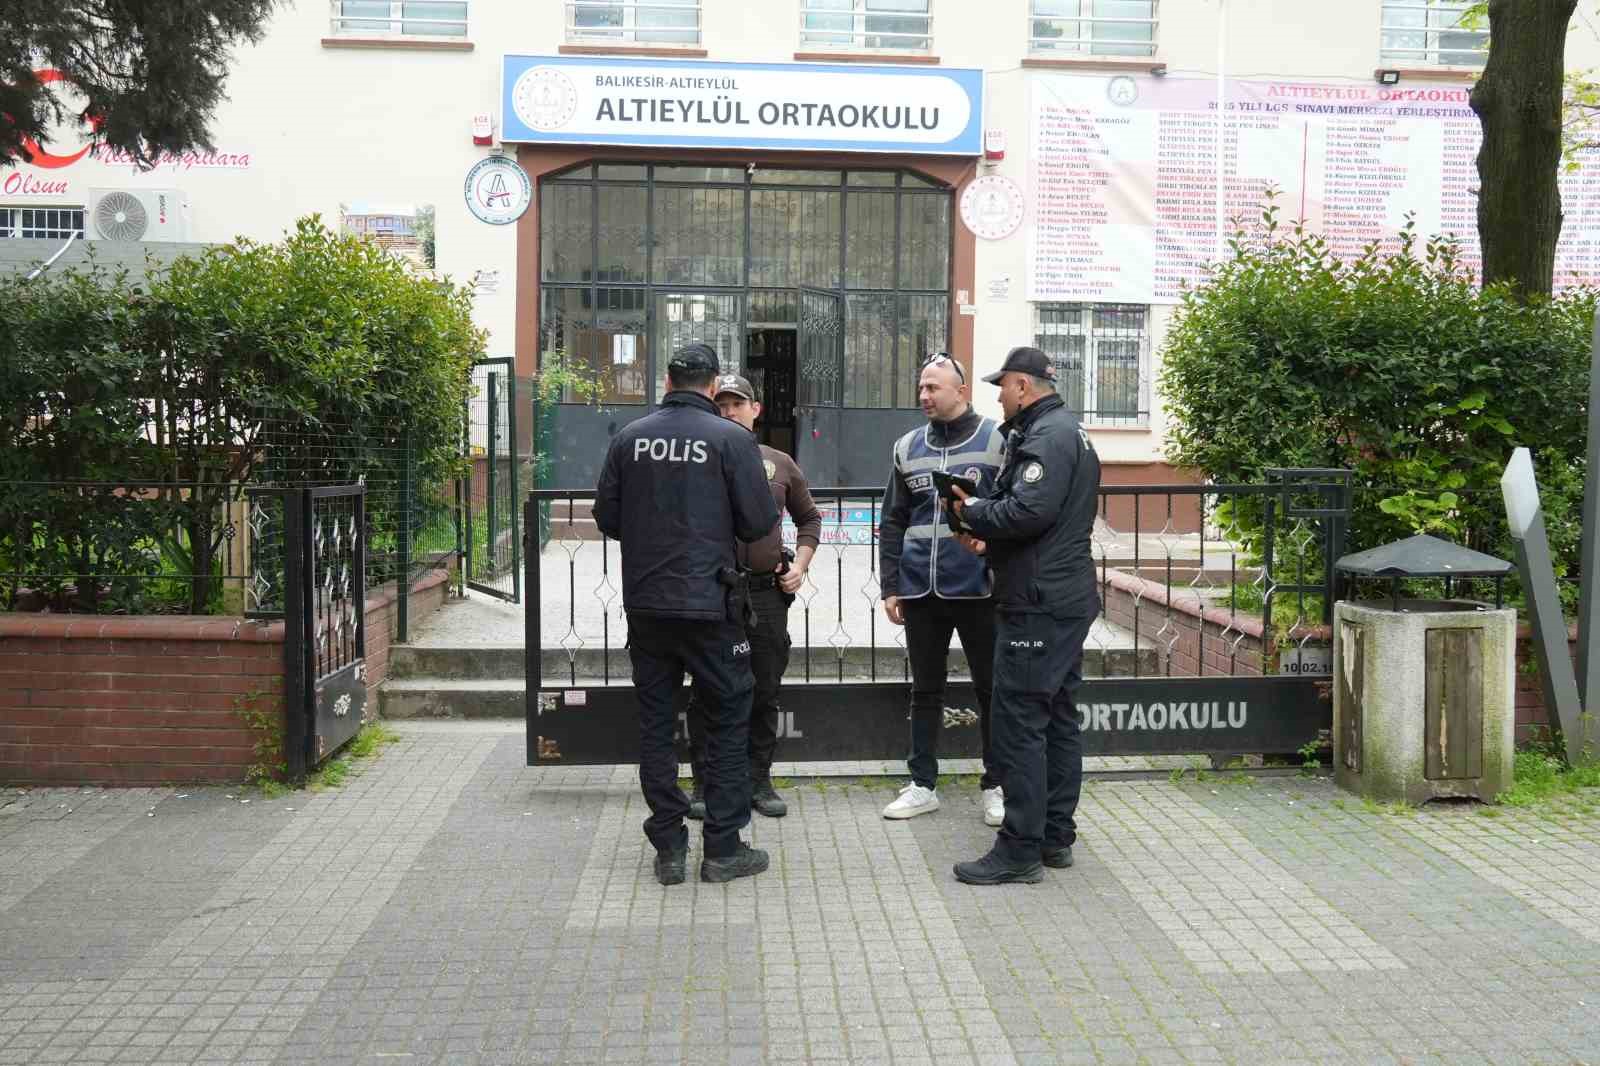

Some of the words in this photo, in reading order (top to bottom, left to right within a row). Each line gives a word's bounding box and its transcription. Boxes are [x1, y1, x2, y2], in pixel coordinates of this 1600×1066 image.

[595, 74, 738, 90] BALIKESİR-ALTIEYLÜL
[1378, 88, 1468, 102] ORTAOKU
[595, 95, 750, 124] ALTIEYLÜL
[758, 102, 940, 130] ORTAOKULU
[1265, 103, 1289, 112] LGS
[4, 172, 70, 195] Olsun
